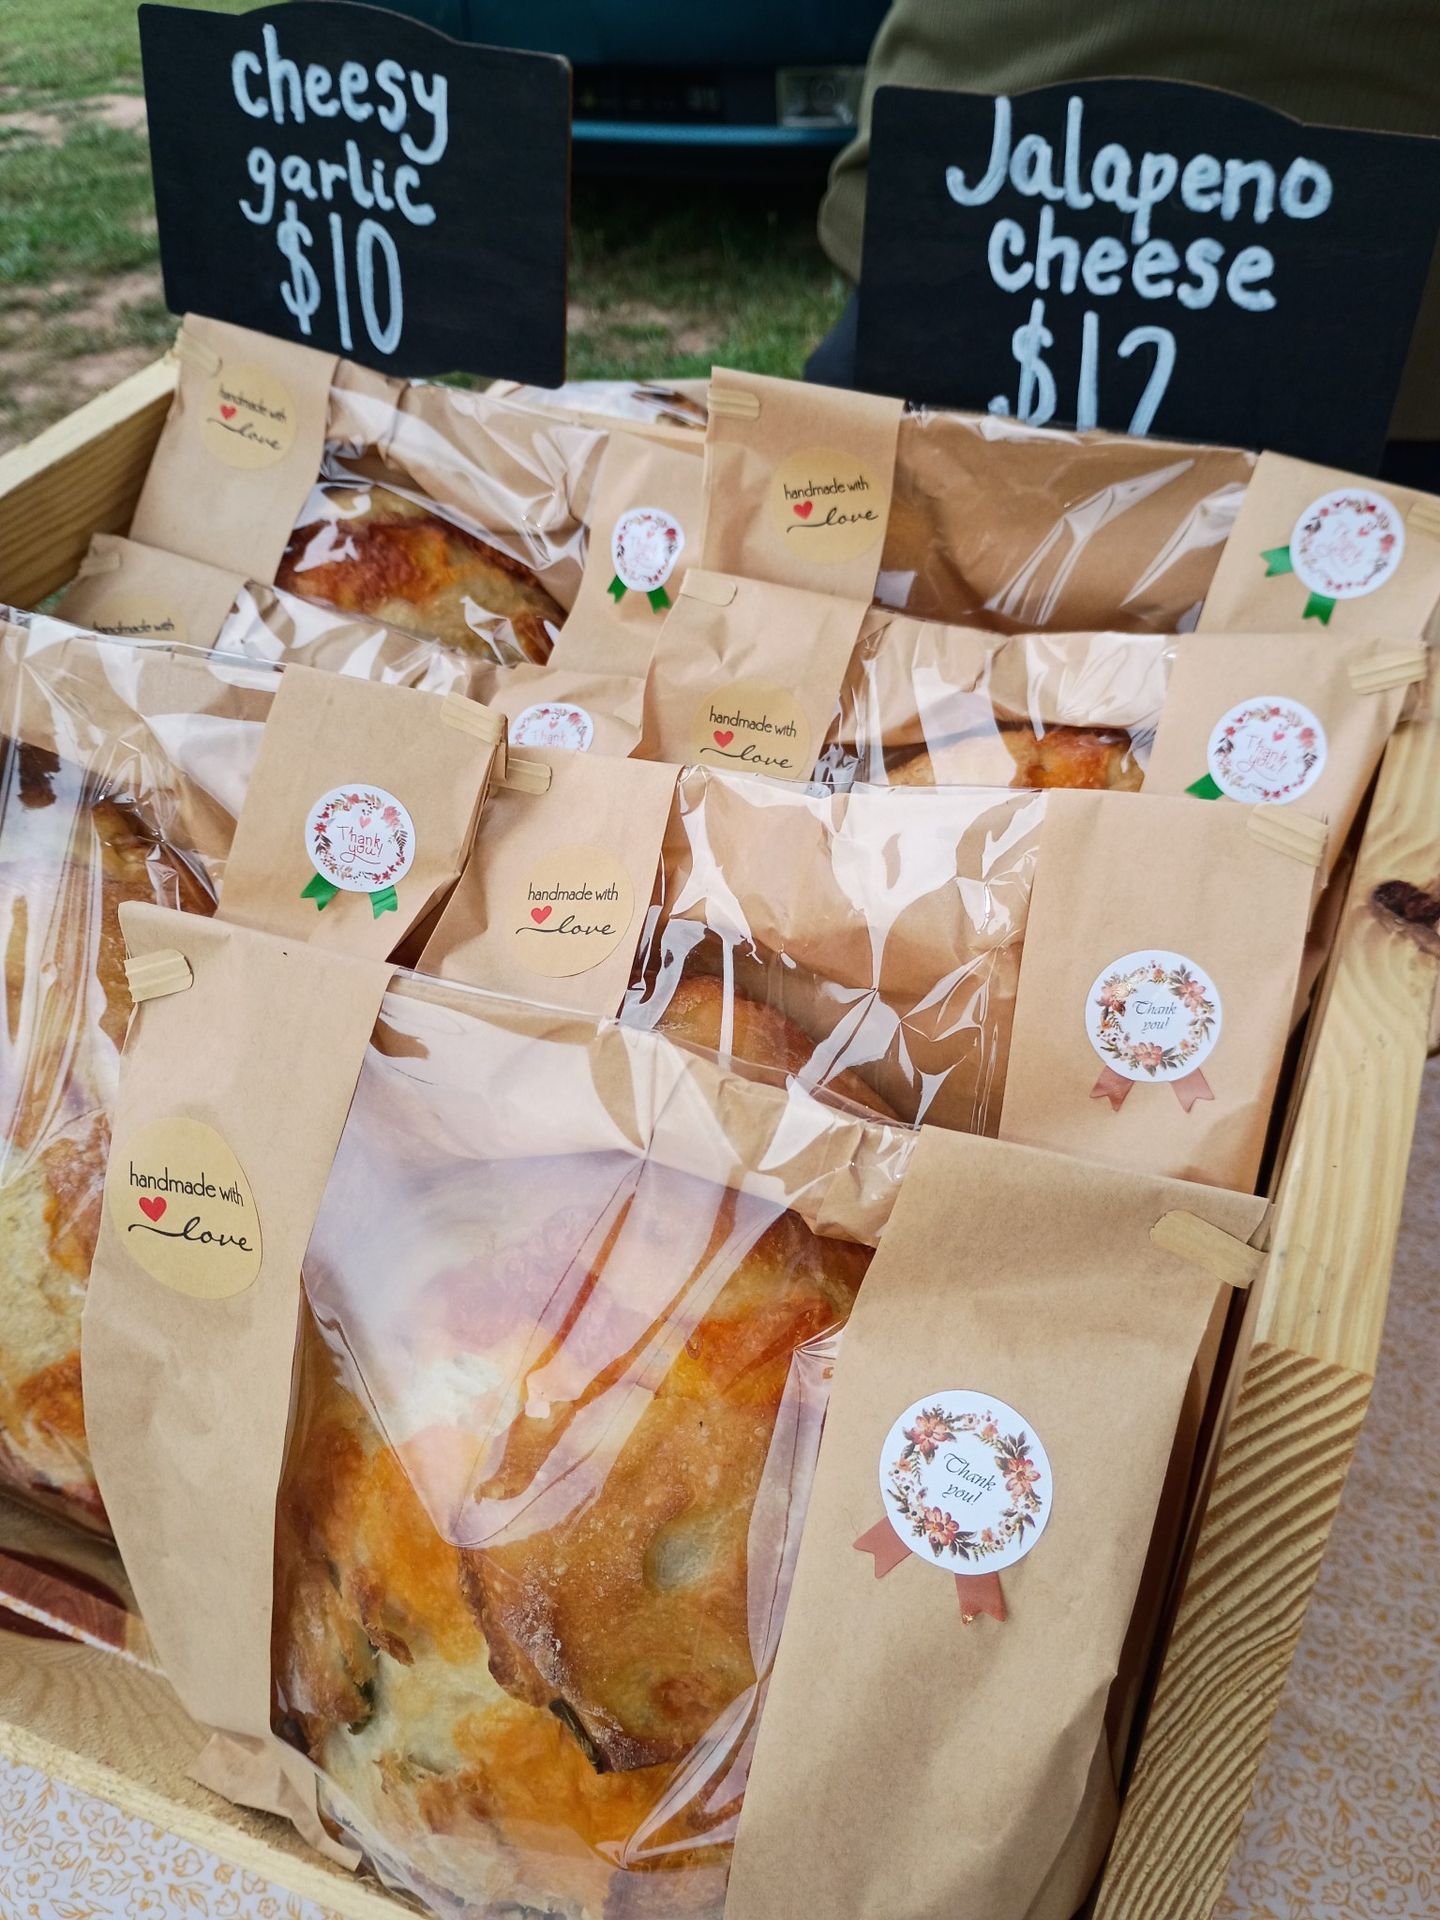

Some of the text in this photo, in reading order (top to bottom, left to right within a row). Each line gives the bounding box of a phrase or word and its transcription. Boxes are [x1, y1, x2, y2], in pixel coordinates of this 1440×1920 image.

[231, 23, 448, 165] cheesy
[238, 138, 436, 226] garlic
[945, 95, 1334, 245] Jalapeno
[276, 200, 403, 355] $10
[783, 475, 870, 501] handmade with
[785, 506, 879, 533] love
[709, 704, 797, 738] handmade with
[699, 744, 793, 769] love
[336, 826, 381, 846] Thank
[339, 843, 384, 865] you!
[527, 881, 619, 901] handmade with
[515, 914, 617, 935] love
[1132, 1000, 1177, 1016] Thank
[1142, 1016, 1171, 1034] you!
[129, 1160, 245, 1207] handmade with
[127, 1215, 253, 1252] love
[943, 1452, 997, 1492] Thank
[941, 1482, 983, 1506] you!
